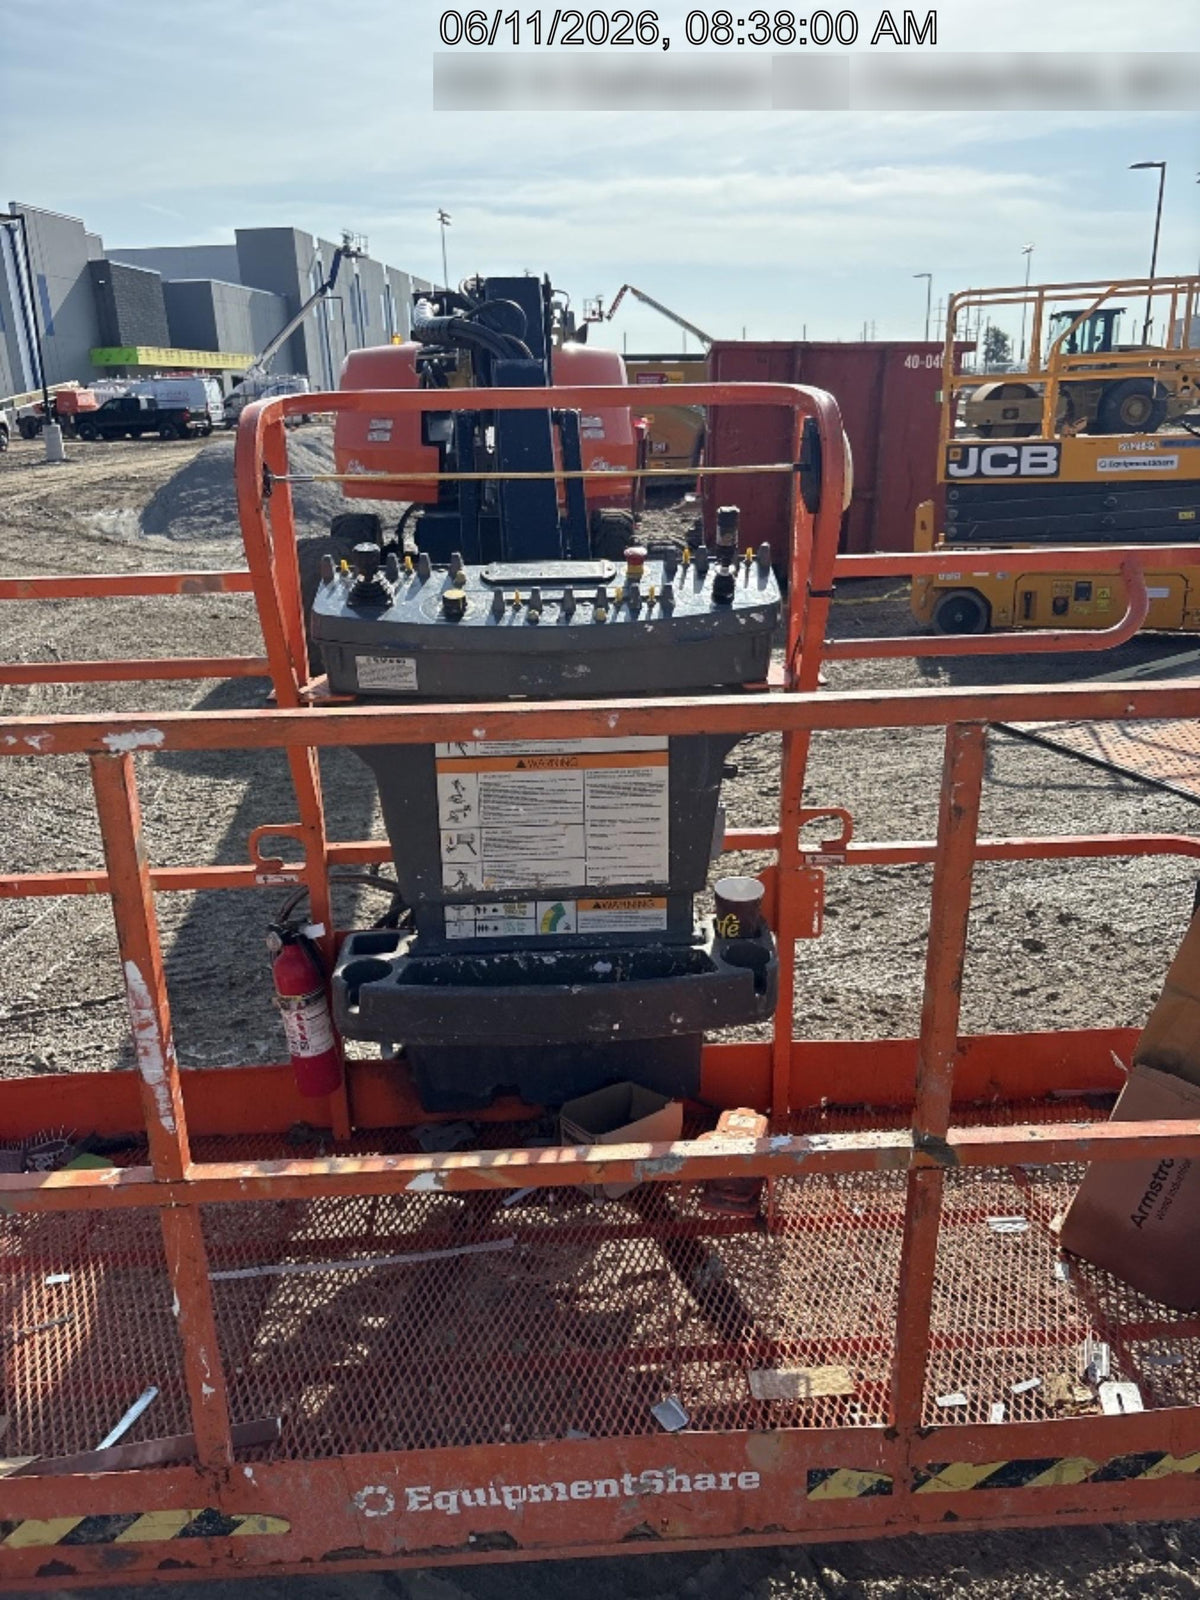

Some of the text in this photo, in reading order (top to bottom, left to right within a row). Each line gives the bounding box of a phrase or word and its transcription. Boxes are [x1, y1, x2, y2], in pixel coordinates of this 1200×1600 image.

[904, 353, 955, 369] 40-04
[949, 445, 1058, 477] JCB
[527, 757, 578, 769] WARNING
[404, 1468, 761, 1515] EquipmentShare
